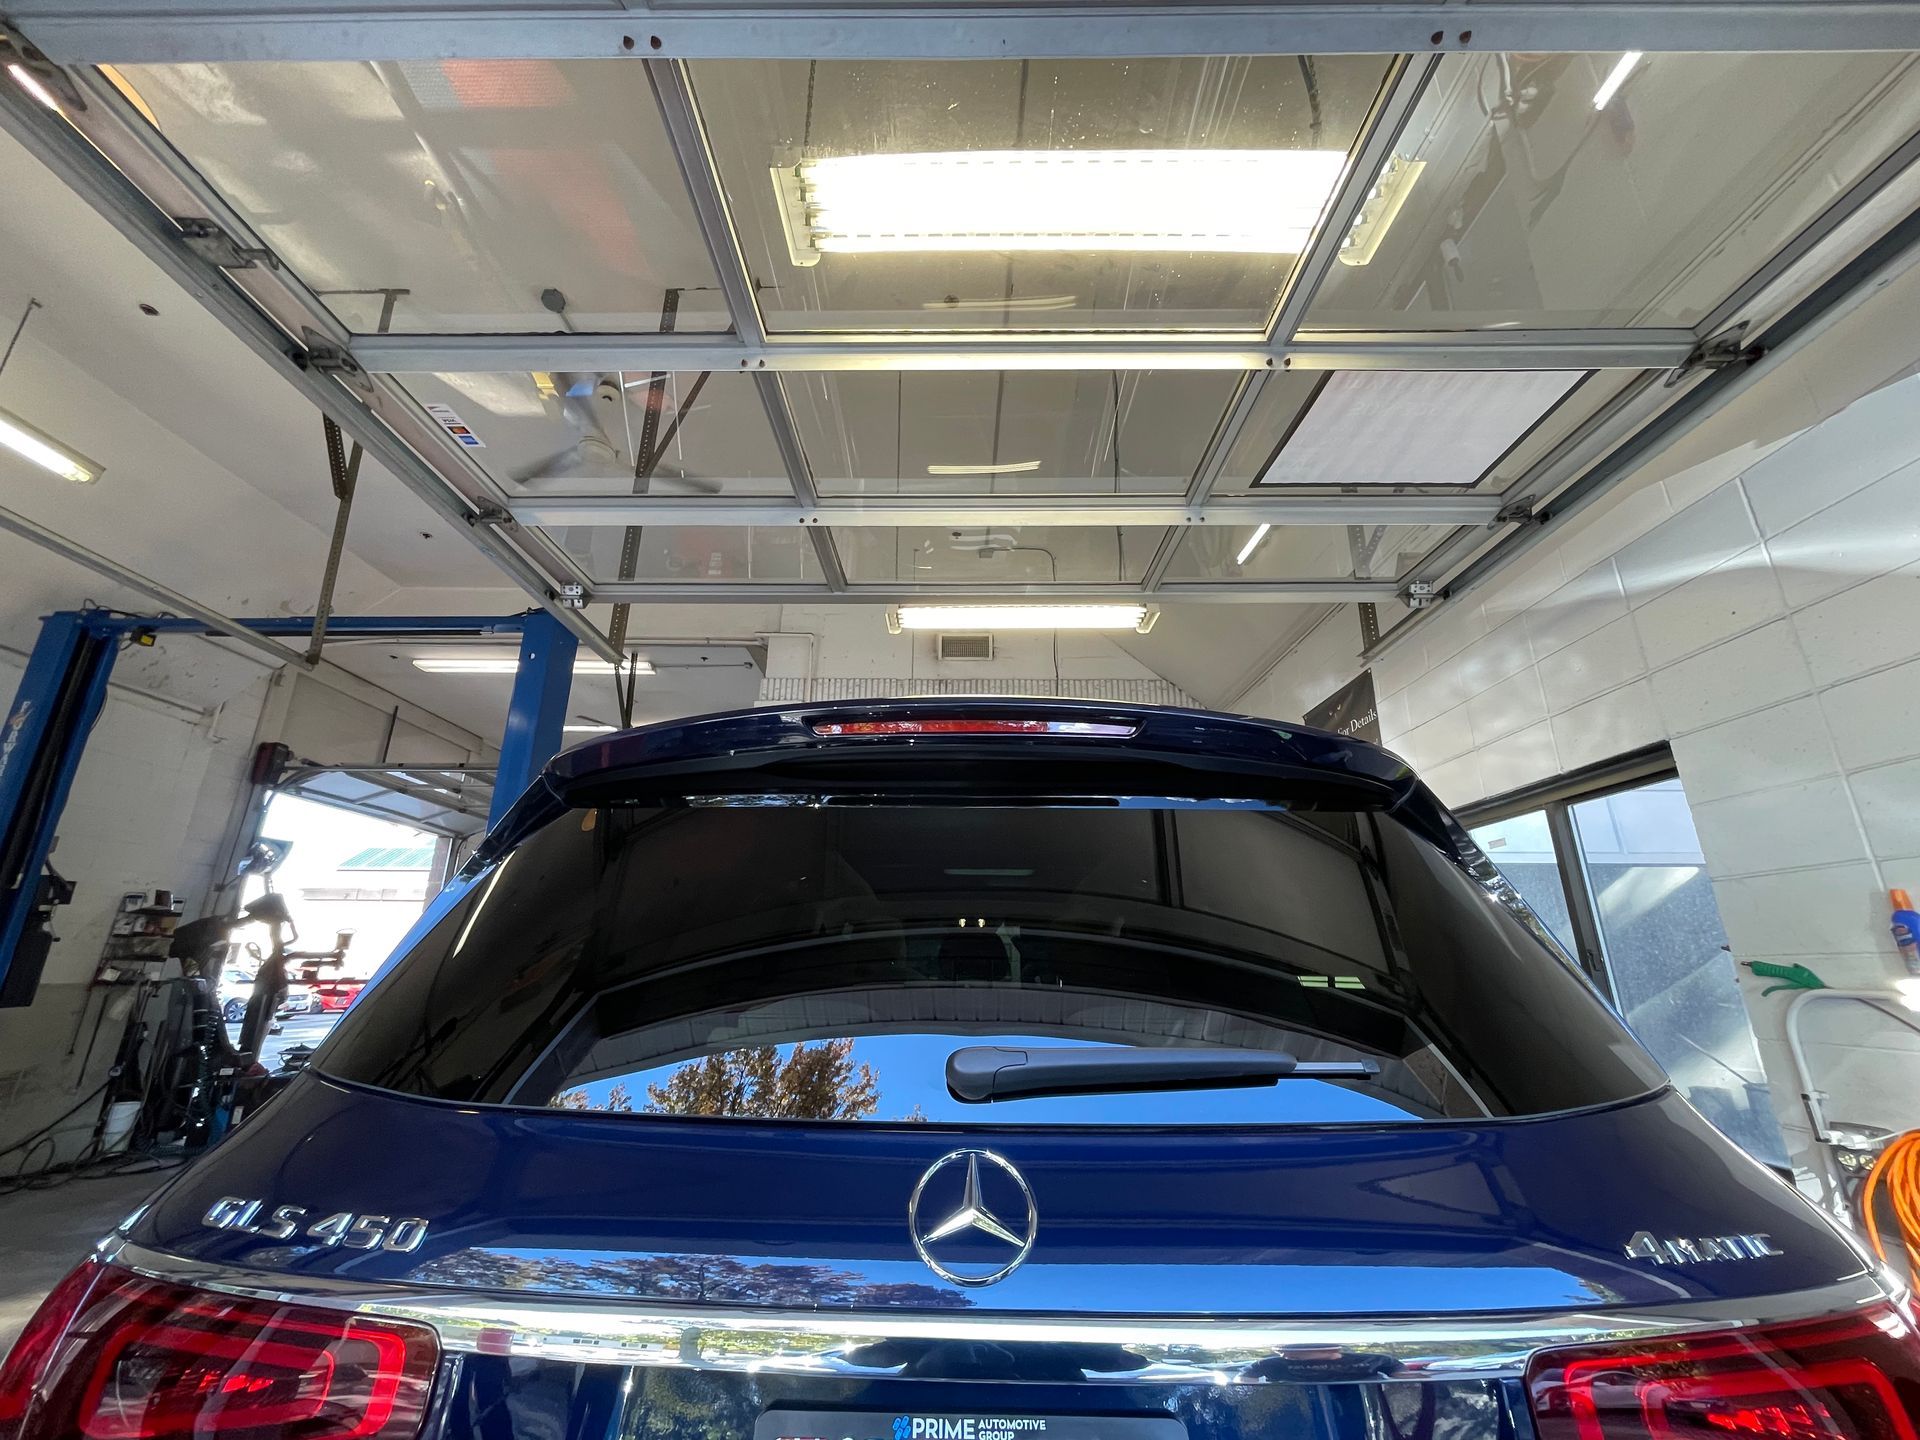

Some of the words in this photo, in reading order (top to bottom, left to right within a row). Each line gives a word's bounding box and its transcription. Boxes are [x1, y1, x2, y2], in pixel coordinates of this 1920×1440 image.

[1350, 708, 1378, 733] Details
[202, 1196, 307, 1240] GLS
[307, 1212, 430, 1253] 450
[1624, 1231, 1784, 1266] 4MATIC
[912, 1417, 975, 1440] PRIME
[978, 1418, 1047, 1431] AUTOMOTIVE
[978, 1430, 1015, 1440] GROUP
